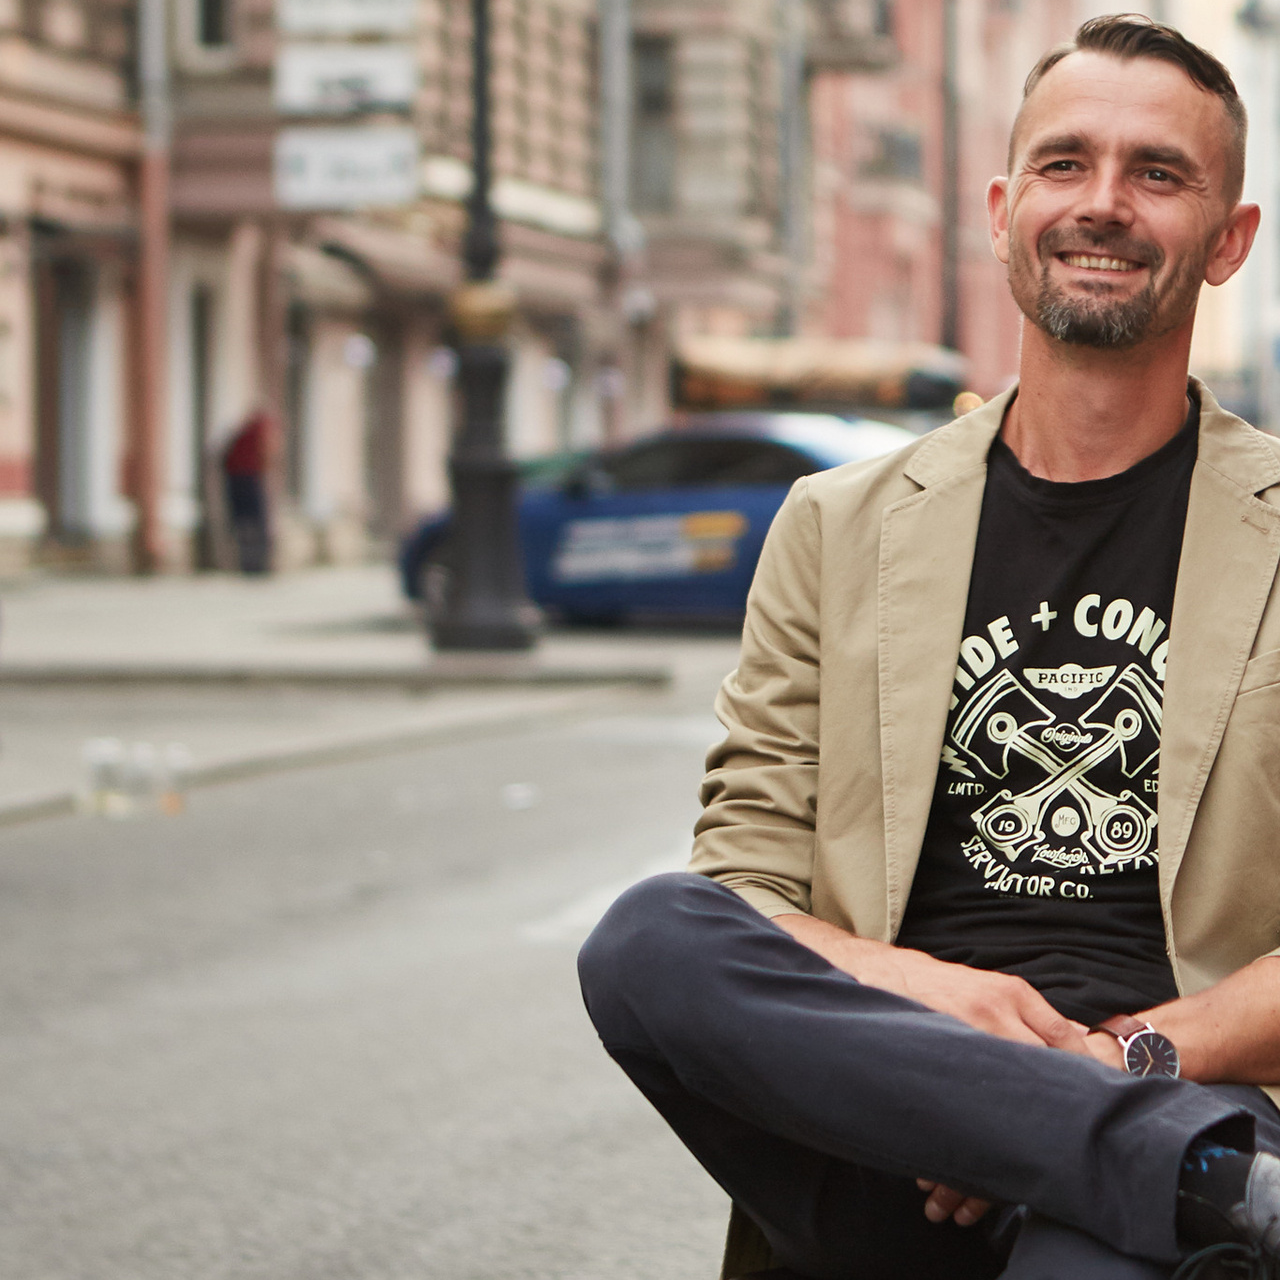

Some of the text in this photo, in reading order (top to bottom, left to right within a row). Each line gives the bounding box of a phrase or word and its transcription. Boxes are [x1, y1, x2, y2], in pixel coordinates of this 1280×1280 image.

[1038, 672, 1103, 684] PACIFIC
[1041, 727, 1093, 746] Originals
[998, 820, 1133, 839] 19 89
[1060, 880, 1094, 899] CO.
